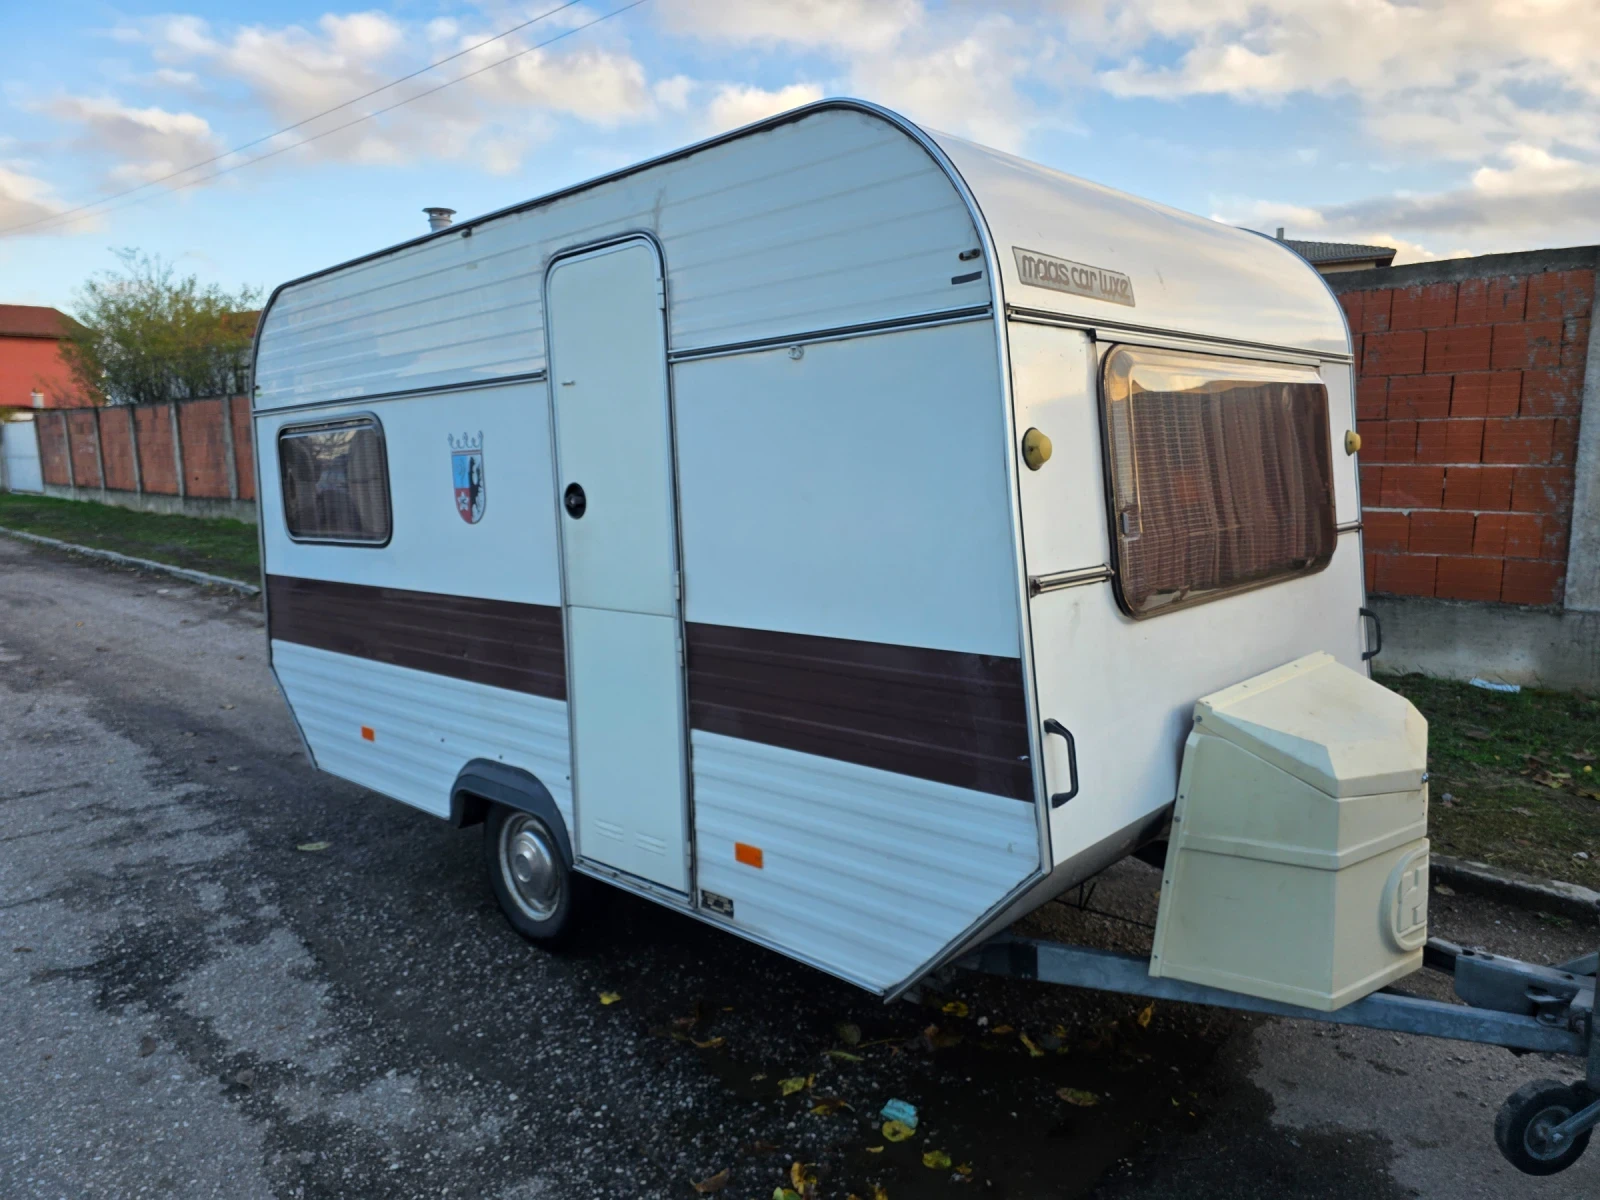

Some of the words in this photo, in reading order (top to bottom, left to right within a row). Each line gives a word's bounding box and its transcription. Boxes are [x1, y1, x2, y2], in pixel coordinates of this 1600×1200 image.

[1022, 255, 1070, 286] maas
[1071, 266, 1097, 292] car
[1099, 270, 1131, 299] luxe
